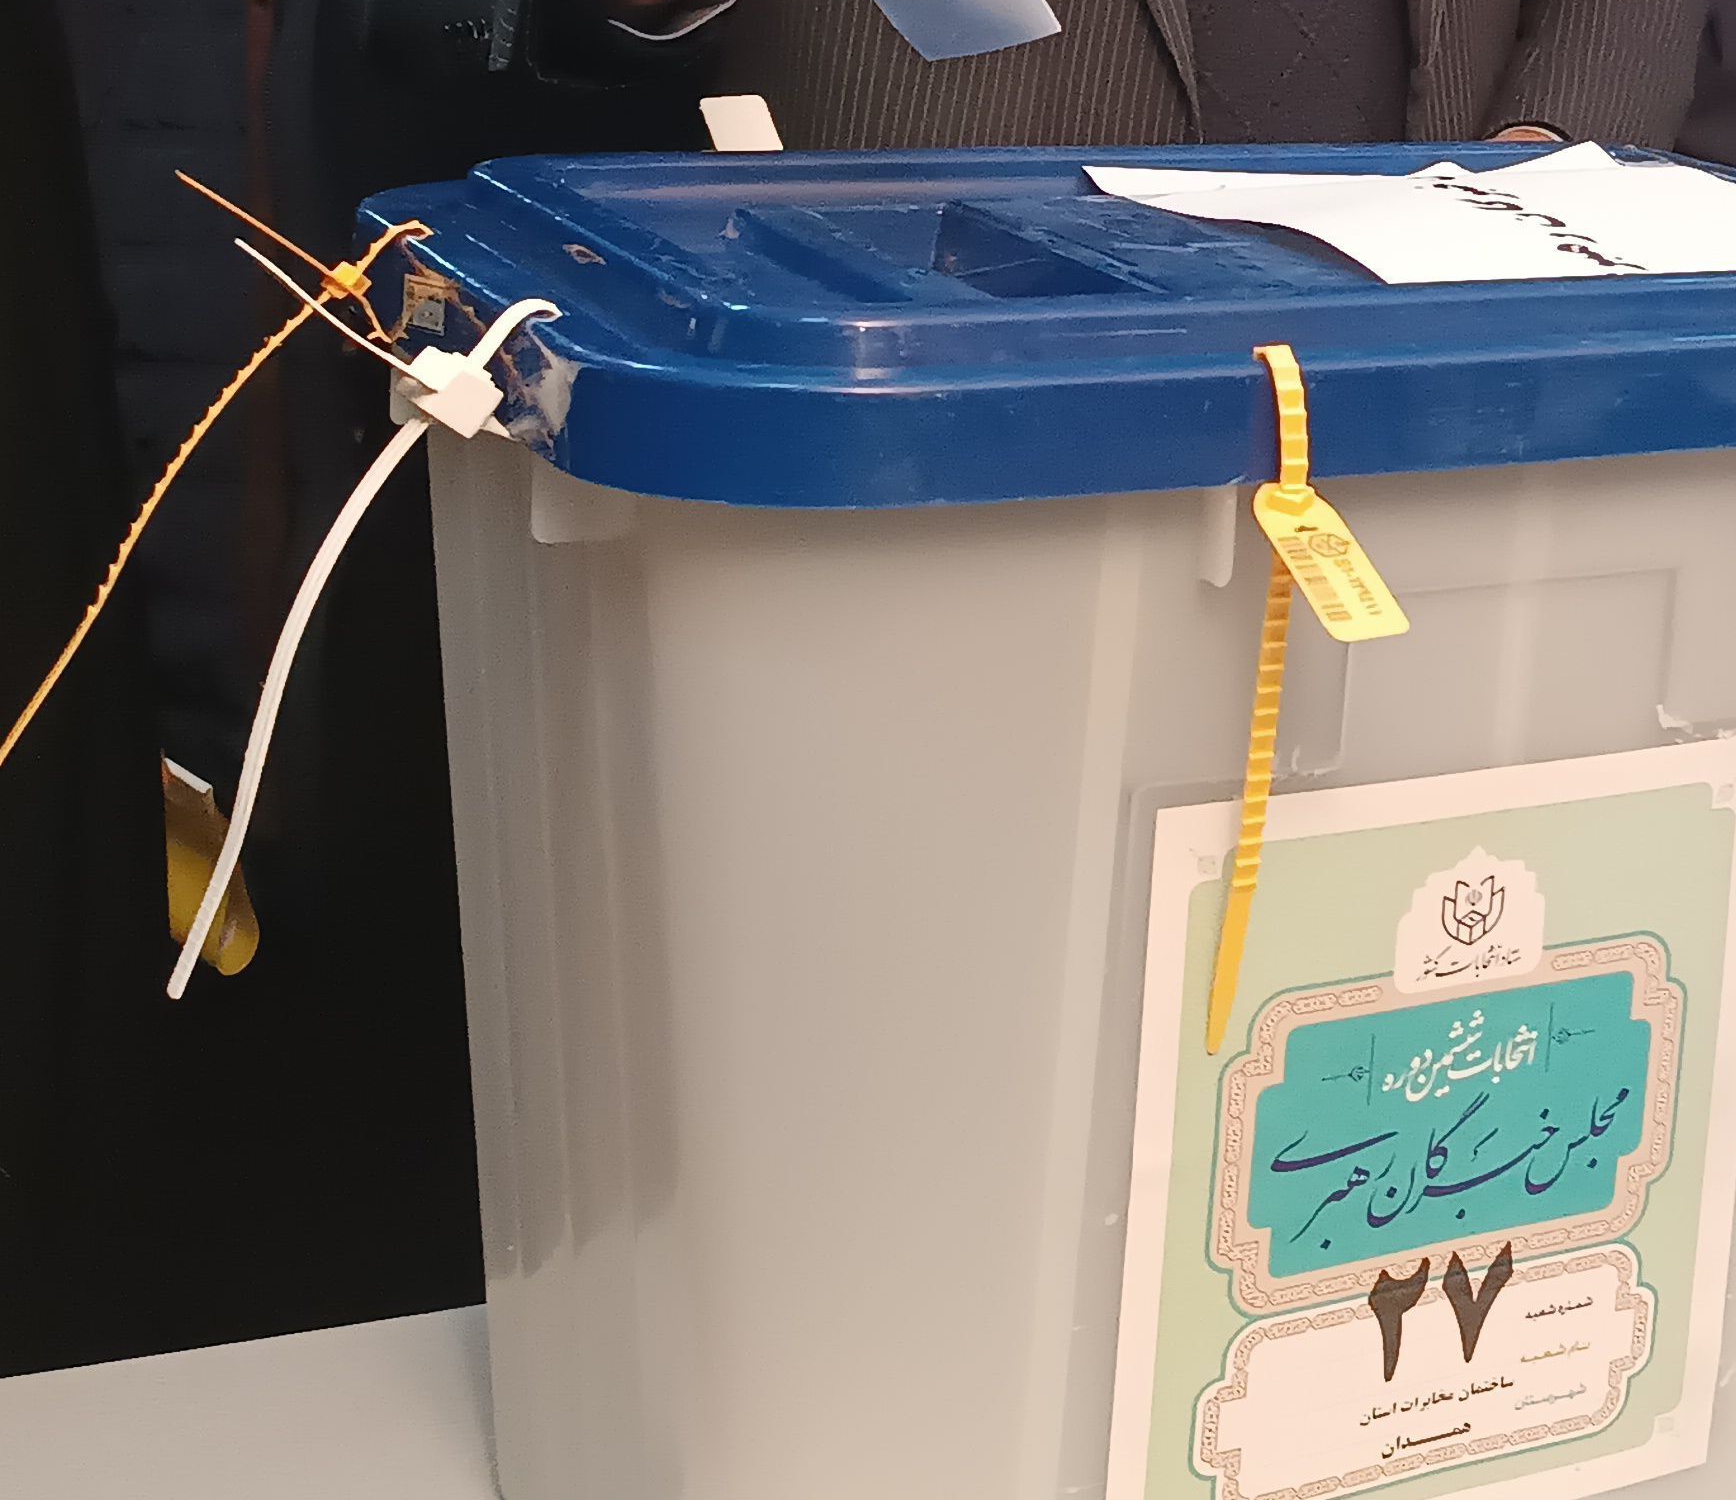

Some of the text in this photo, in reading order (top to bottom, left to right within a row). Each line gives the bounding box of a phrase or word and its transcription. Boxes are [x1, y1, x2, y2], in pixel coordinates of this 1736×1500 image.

[1381, 1010, 1540, 1102] انتخابات ششمین دوره
[1270, 1087, 1631, 1250] مجلس خبرگان رهبری
[1368, 1240, 1515, 1383] ۲۷
[1359, 1376, 1515, 1427] ساختمان مخابرات استان
